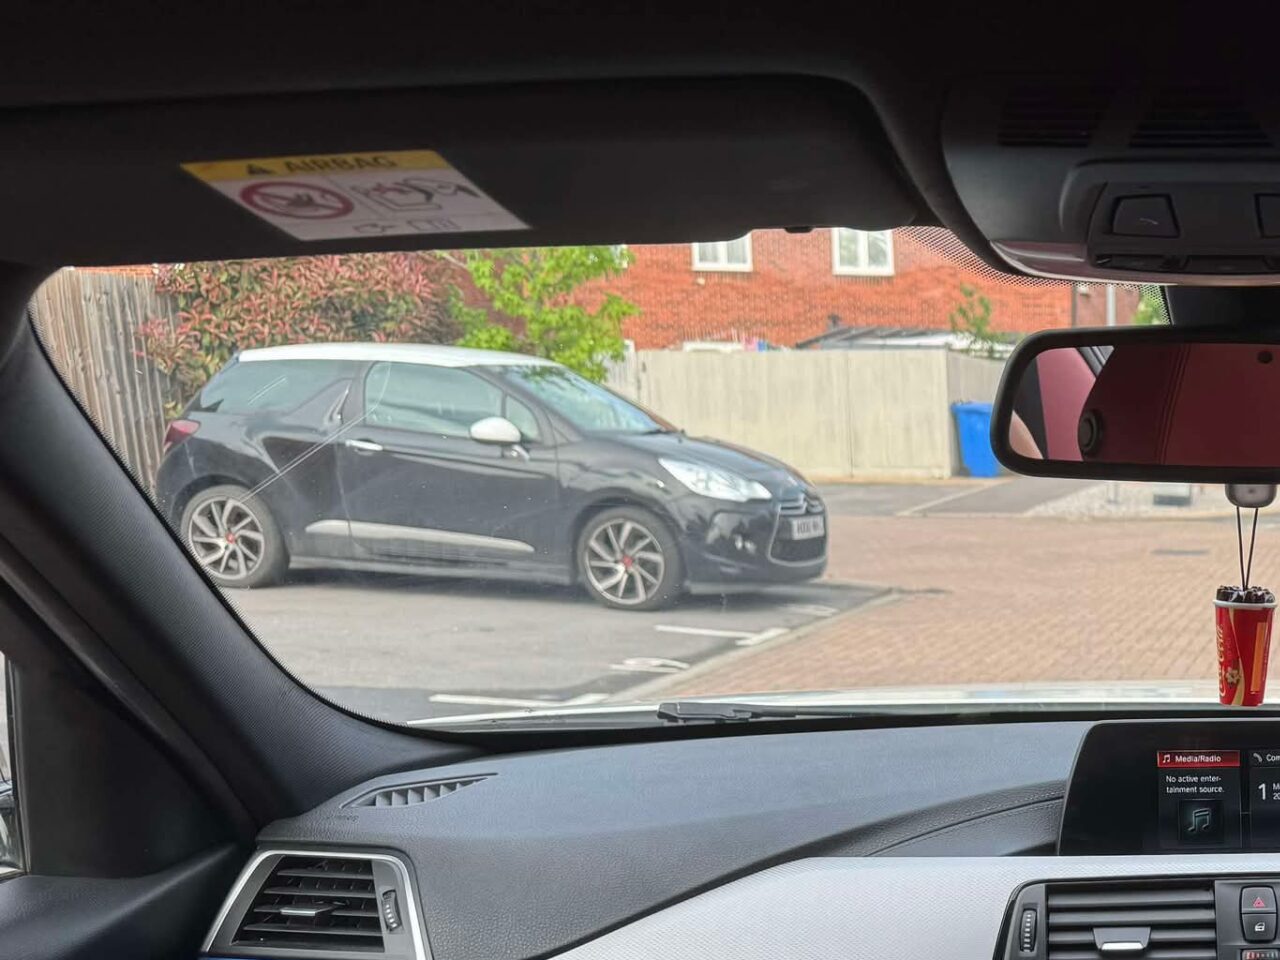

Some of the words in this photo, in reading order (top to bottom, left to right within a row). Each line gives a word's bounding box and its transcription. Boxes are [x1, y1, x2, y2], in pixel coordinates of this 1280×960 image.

[284, 156, 398, 174] AIRBAG
[1175, 755, 1222, 763] Media/Radio
[1178, 775, 1199, 783] active
[1200, 775, 1222, 783] enter-
[1258, 783, 1266, 800] 1
